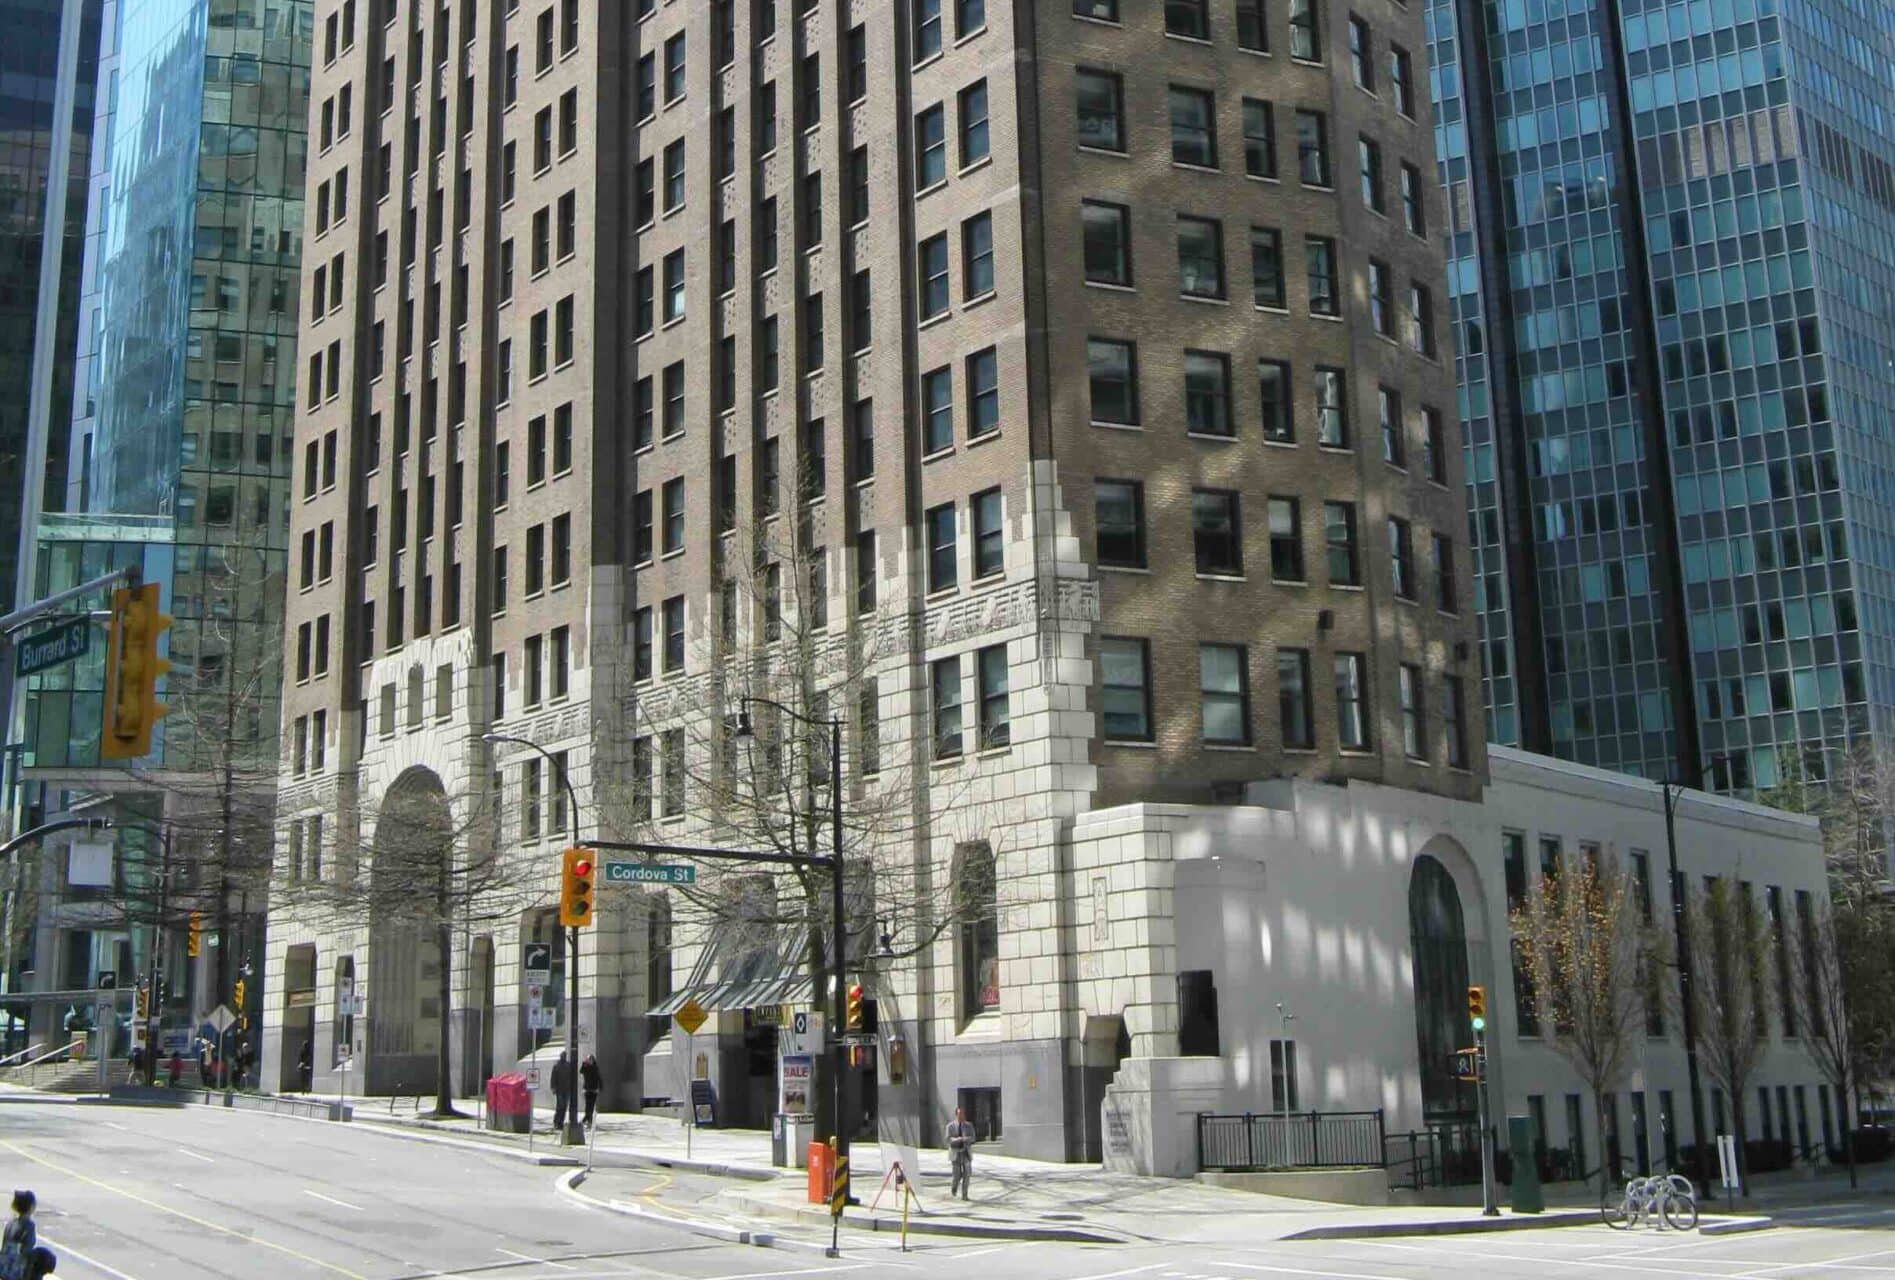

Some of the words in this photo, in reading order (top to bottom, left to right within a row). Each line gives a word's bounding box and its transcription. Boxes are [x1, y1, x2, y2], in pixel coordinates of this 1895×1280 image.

[22, 637, 66, 670] Burrard
[72, 624, 85, 653] St
[612, 865, 668, 880] Cordova
[674, 867, 689, 881] St
[784, 1067, 809, 1077] SALE
